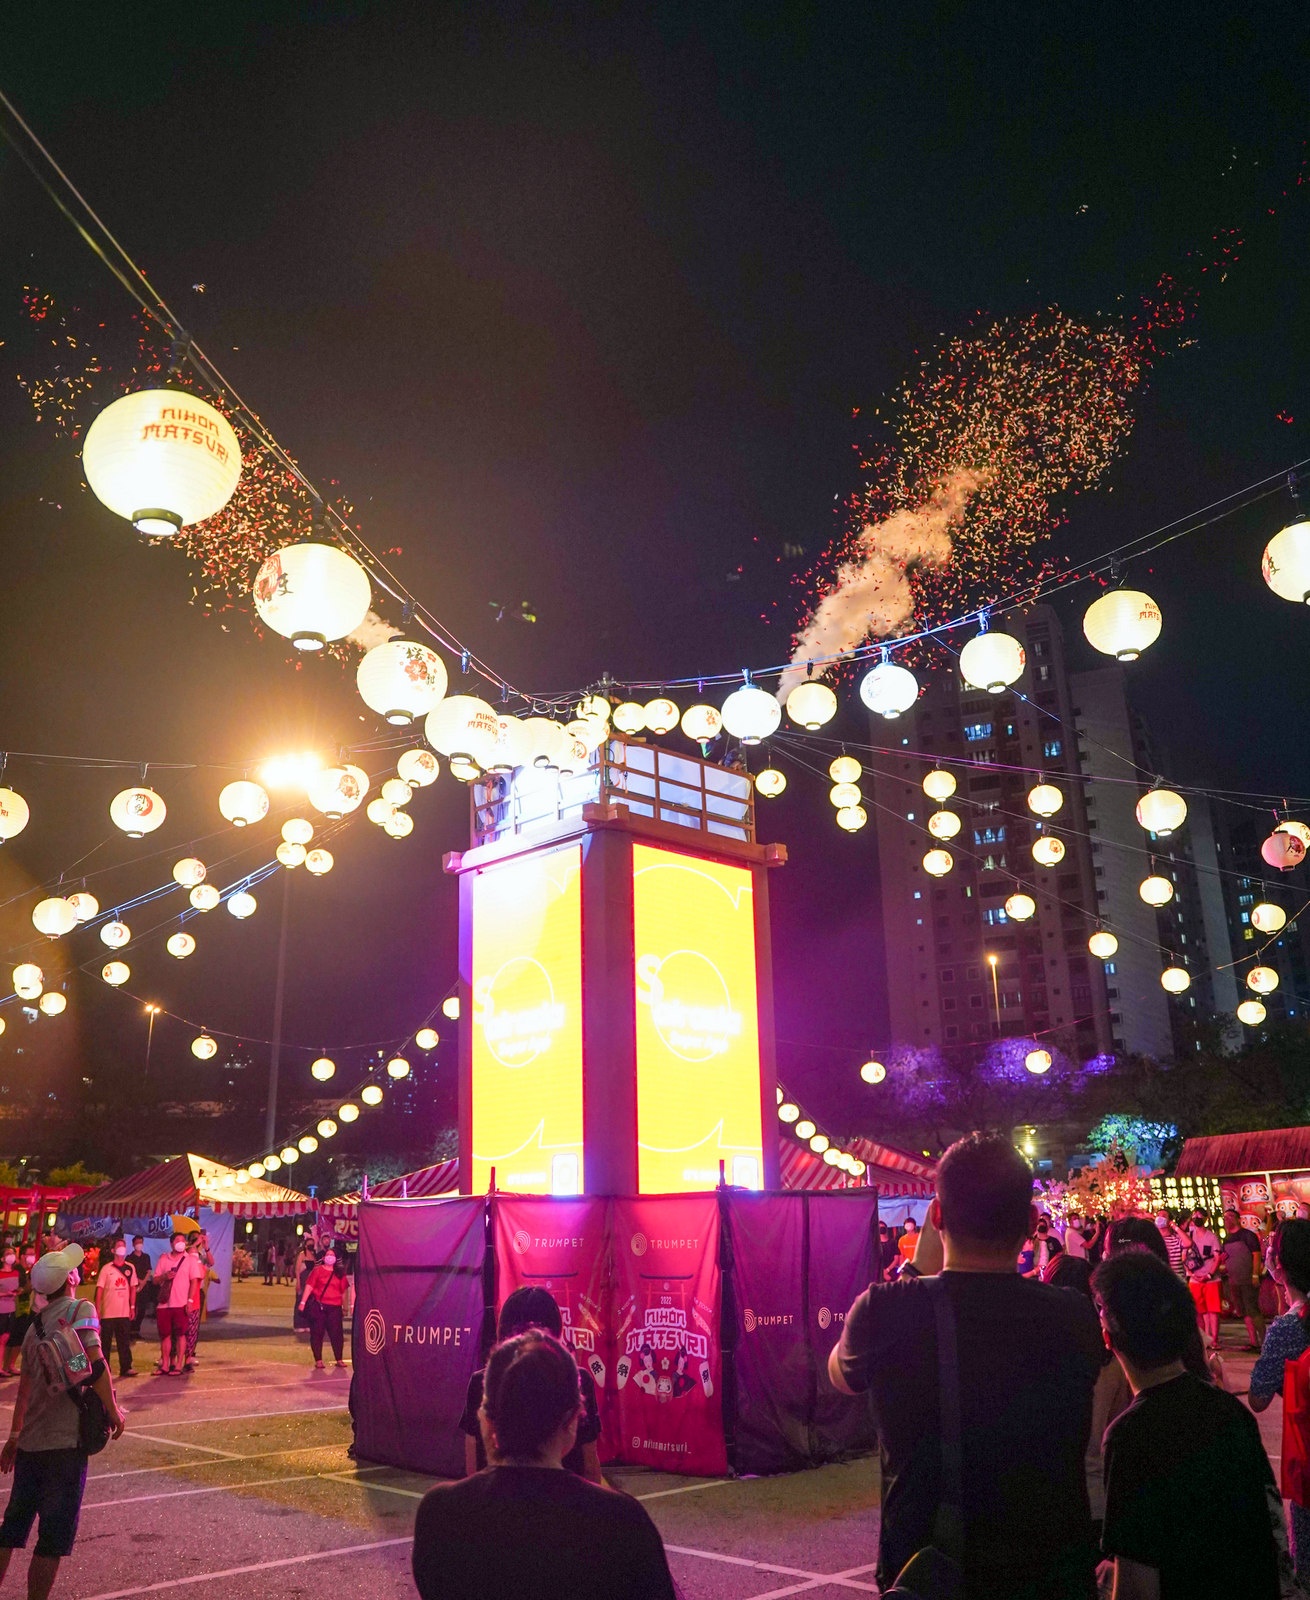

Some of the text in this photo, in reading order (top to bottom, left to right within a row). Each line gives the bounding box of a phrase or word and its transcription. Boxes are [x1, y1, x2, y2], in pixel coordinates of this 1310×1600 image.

[161, 407, 220, 437] NIHON
[141, 423, 229, 465] MATSURI
[534, 1237, 585, 1248] TRUMPET
[650, 1239, 699, 1249] TRUMPET
[660, 1296, 672, 1305] 2022
[645, 1307, 687, 1329] NIHON
[625, 1326, 708, 1359] MATSURI
